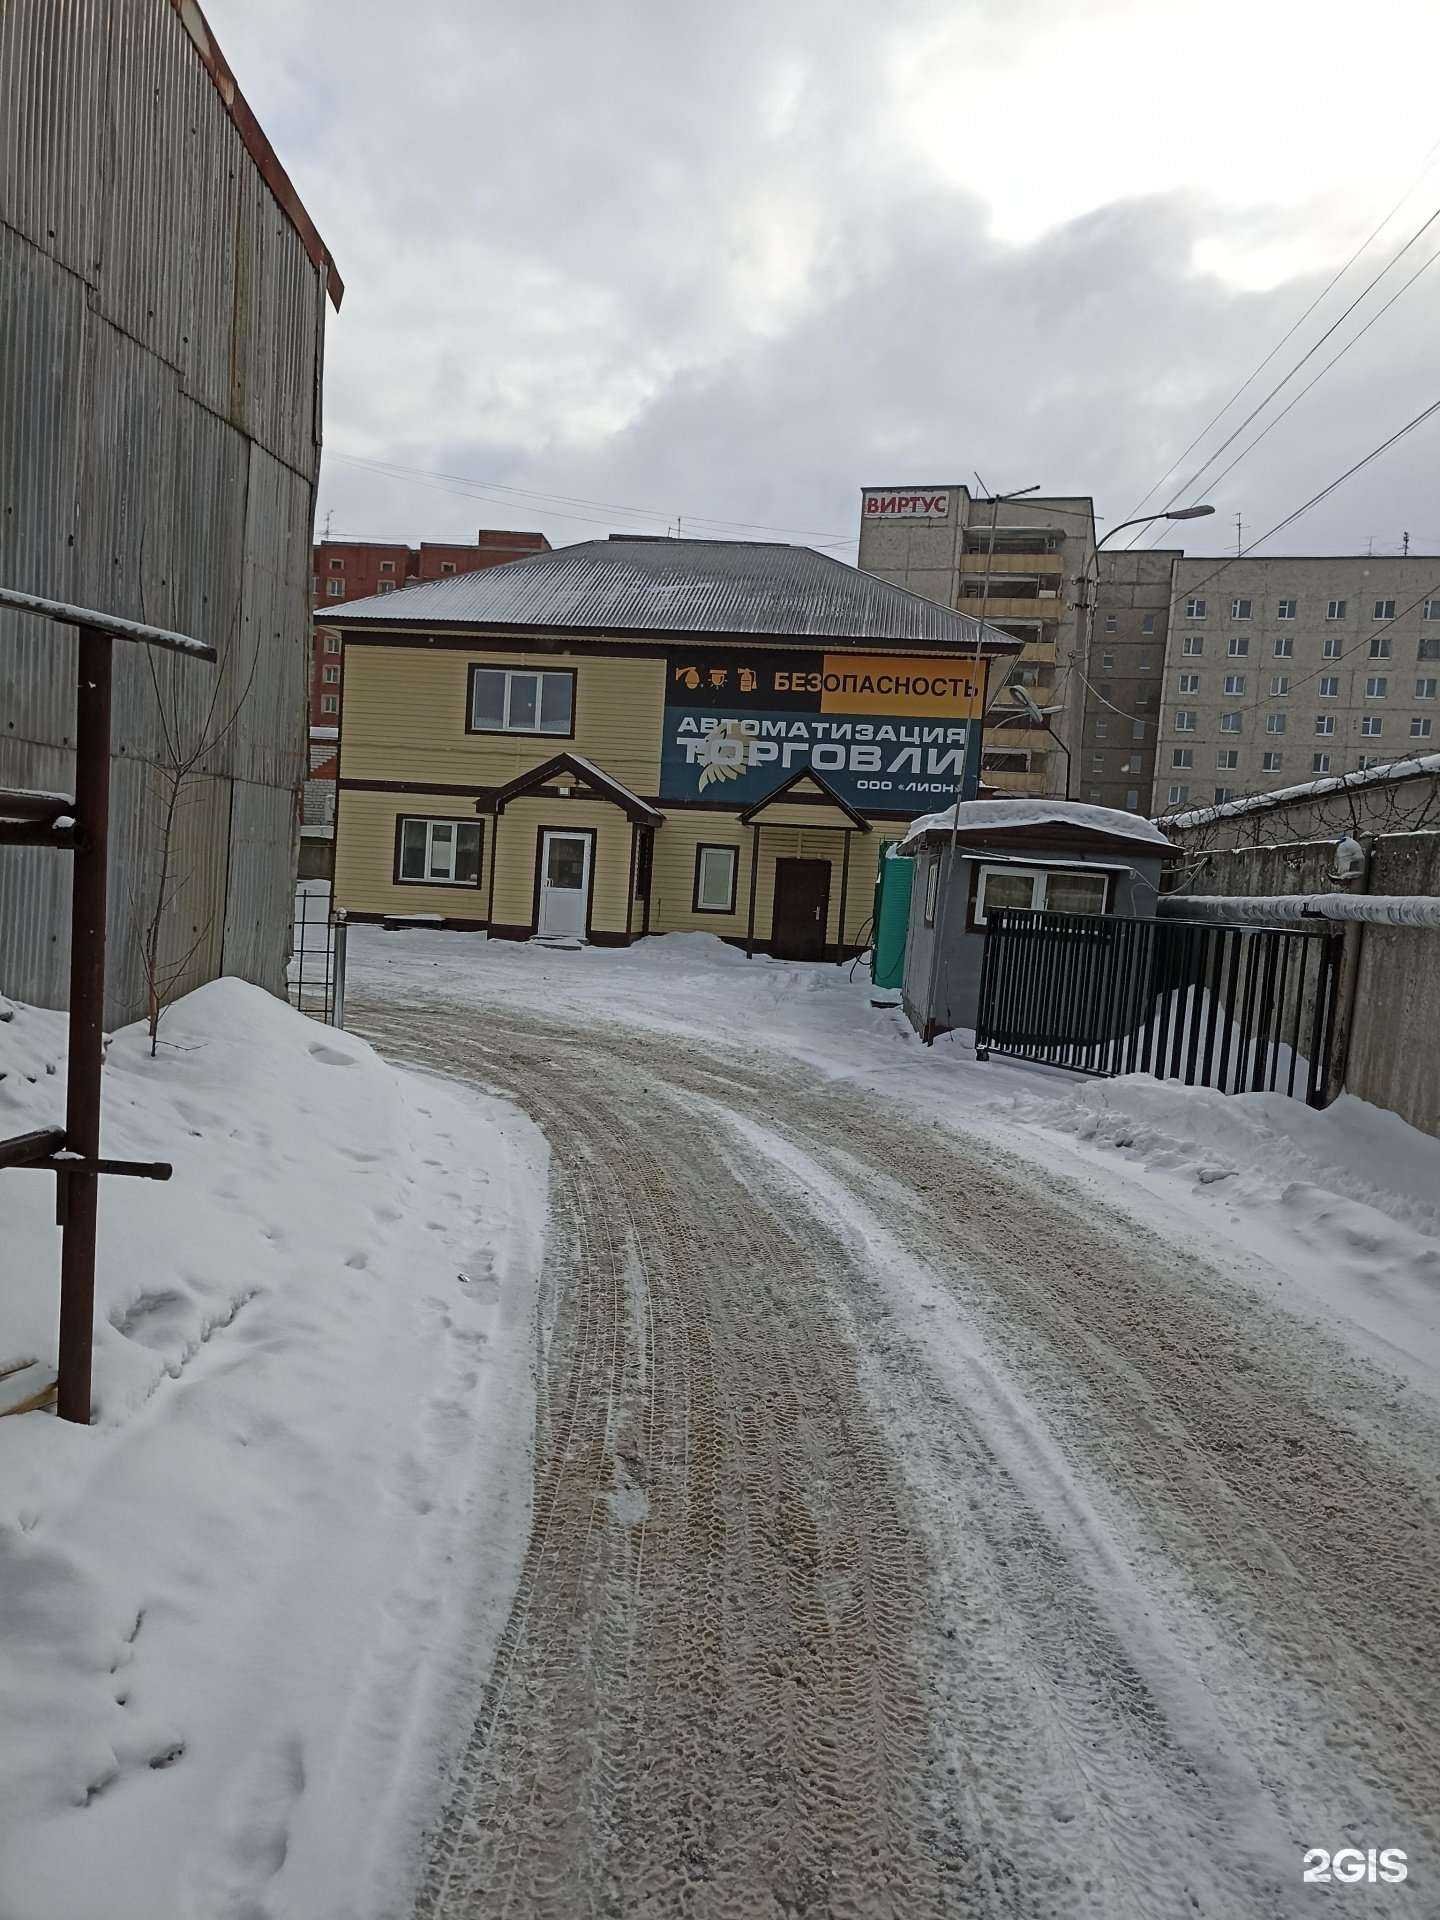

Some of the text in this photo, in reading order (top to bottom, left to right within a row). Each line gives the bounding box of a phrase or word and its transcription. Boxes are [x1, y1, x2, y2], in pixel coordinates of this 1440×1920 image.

[867, 496, 946, 513] ВИРТУС
[774, 672, 979, 698] БЕЗОПАСНОСТЬ
[677, 717, 967, 744] АВТОМАТИЗАЦИЯ
[677, 737, 966, 775] ТОРГОВЛИ
[857, 780, 892, 791] ООО
